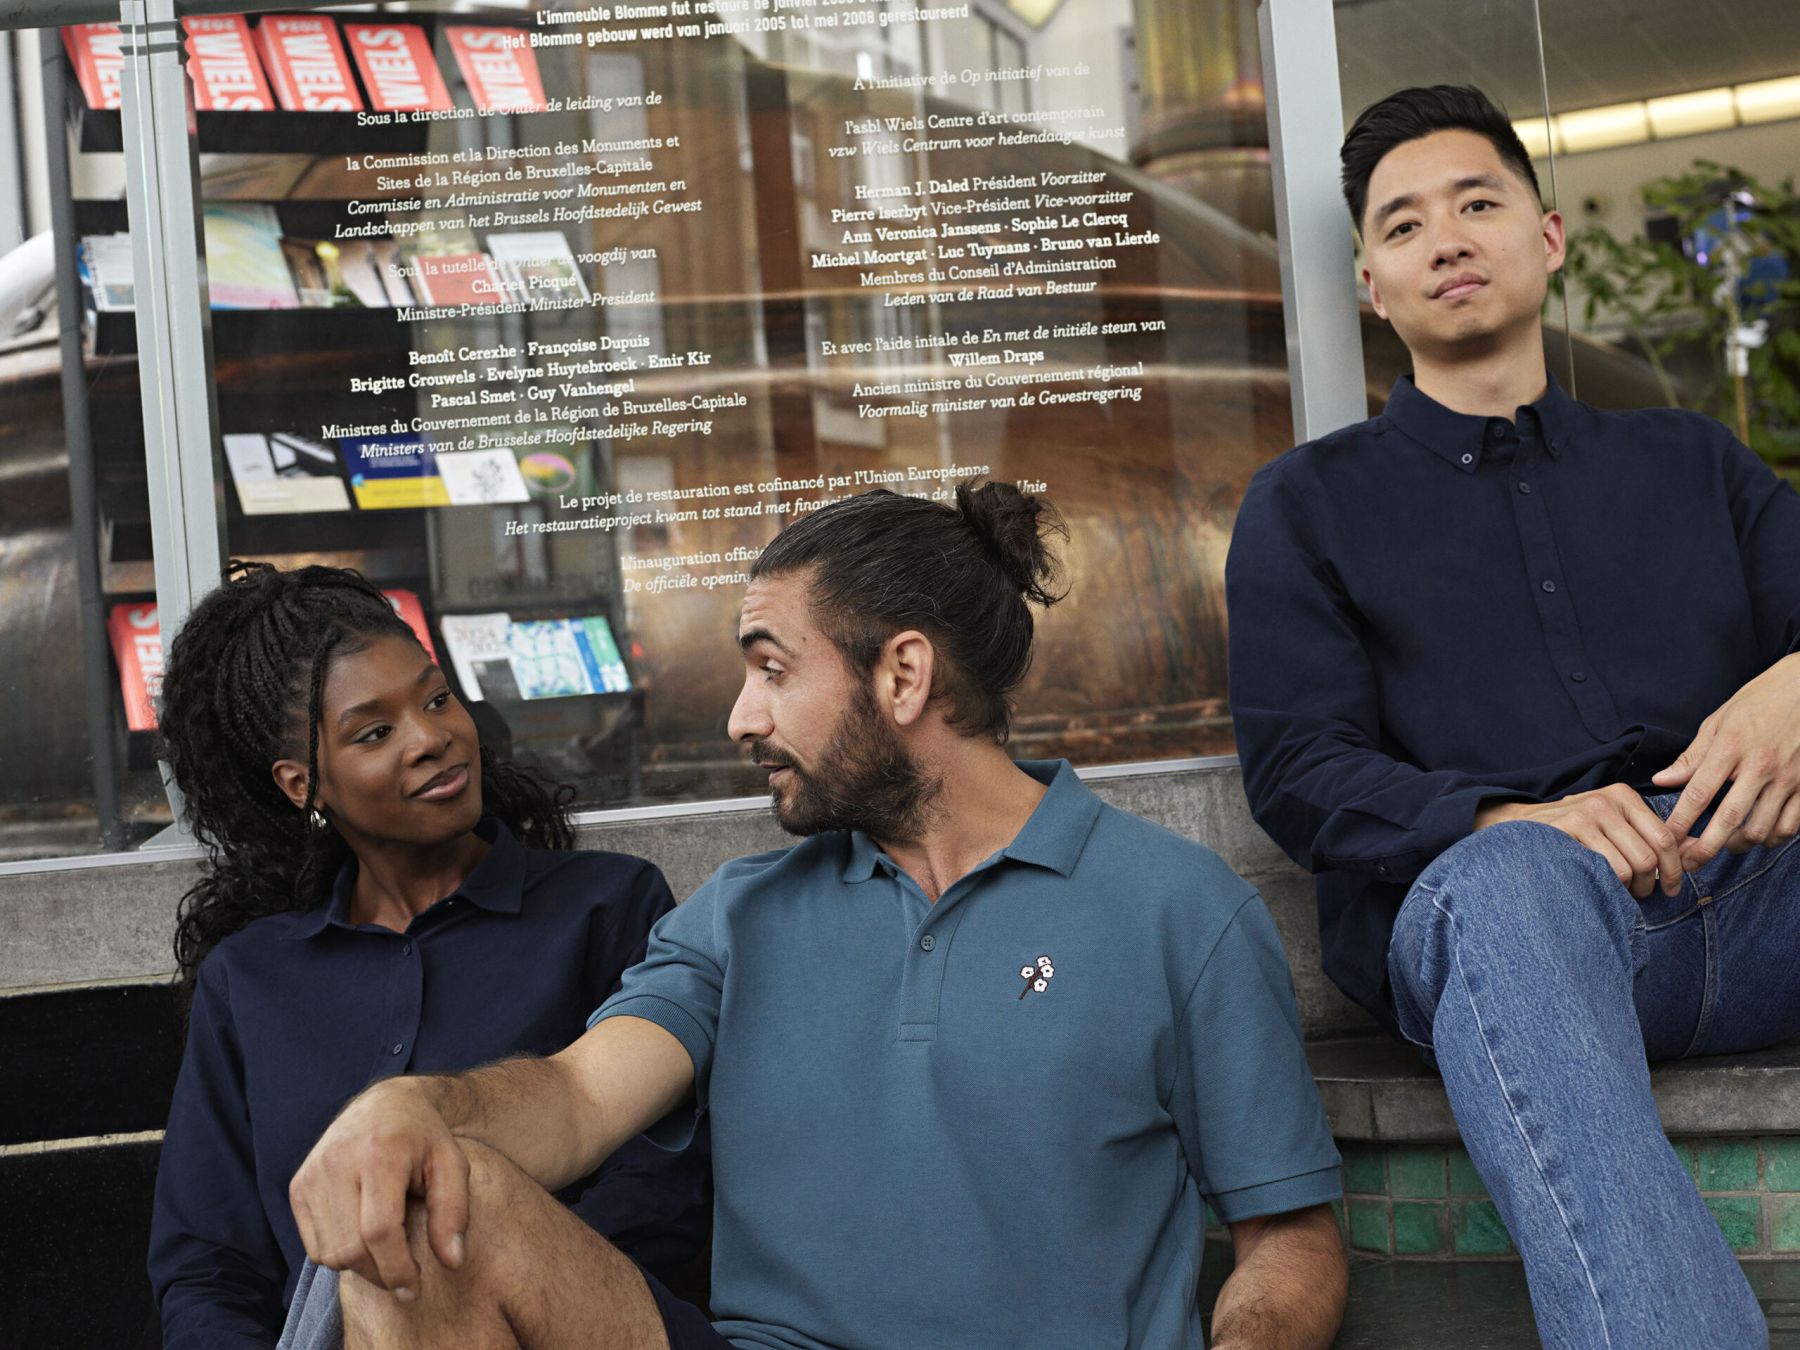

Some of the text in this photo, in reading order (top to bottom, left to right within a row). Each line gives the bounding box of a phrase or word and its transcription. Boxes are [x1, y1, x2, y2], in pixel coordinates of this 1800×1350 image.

[502, 3, 969, 48] Het Blomme gebouw werd van januari 2005 tot mei 2008 gerestaureerd
[536, 1, 691, 25] L'immeuble Blomme fut
[358, 28, 429, 107] WIELS
[462, 31, 534, 109] WIELS
[356, 90, 662, 126] Sous la direction de leiding van de
[845, 104, 1105, 135] l'asbl Wiels Centre d'art contemporain
[346, 135, 680, 171] la Commission et la Direction des Monuments et
[828, 136, 996, 157] vzw Wiels Centrum voor
[376, 158, 653, 191] Sites de la Région de Bruxelles-Capitale
[854, 170, 1107, 199] Herman J. Daled Président Voorzitter
[346, 180, 687, 215] Commissie en Administratie voor Monumenten en
[831, 190, 1134, 223] Pierre Iserbyt Vice-Président Vice-voorzitter
[333, 199, 702, 238] Landschappen van het Brussels Hoofdstedelijk Gewest
[841, 213, 1129, 244] Ann Veronica Janssens Sophie Le Clercq
[811, 229, 1159, 268] Michel Moortgat Luc Tuymans Bruno van Lierde
[860, 257, 1117, 286] Membres du Conseil d'Administration
[396, 291, 655, 321] Ministre-Président Minister-President
[408, 334, 650, 365] Benoît Cerexhe Françoise Dupuis
[821, 320, 1166, 355] Et avec l'aide initale de En met de initiële steun van
[350, 350, 711, 394] Brigitte Grouwels Evelyne Huytebroeck Emir Kir
[948, 349, 1044, 366] Willem Draps
[430, 378, 634, 408] Pascal Smet Guy Vanhengel
[851, 361, 1143, 397] Ancien ministre du Gouvernement régional
[321, 394, 747, 439] Ministres du Gouvernement de la Région de Bruxelles-Capitale
[858, 386, 1142, 418] Voormalig minister van de Gewestregering
[559, 464, 989, 511] Le projet de restauration est cofinancé par l'Union Européenne
[504, 501, 791, 535] Het restauratieproject kwam tot stand met
